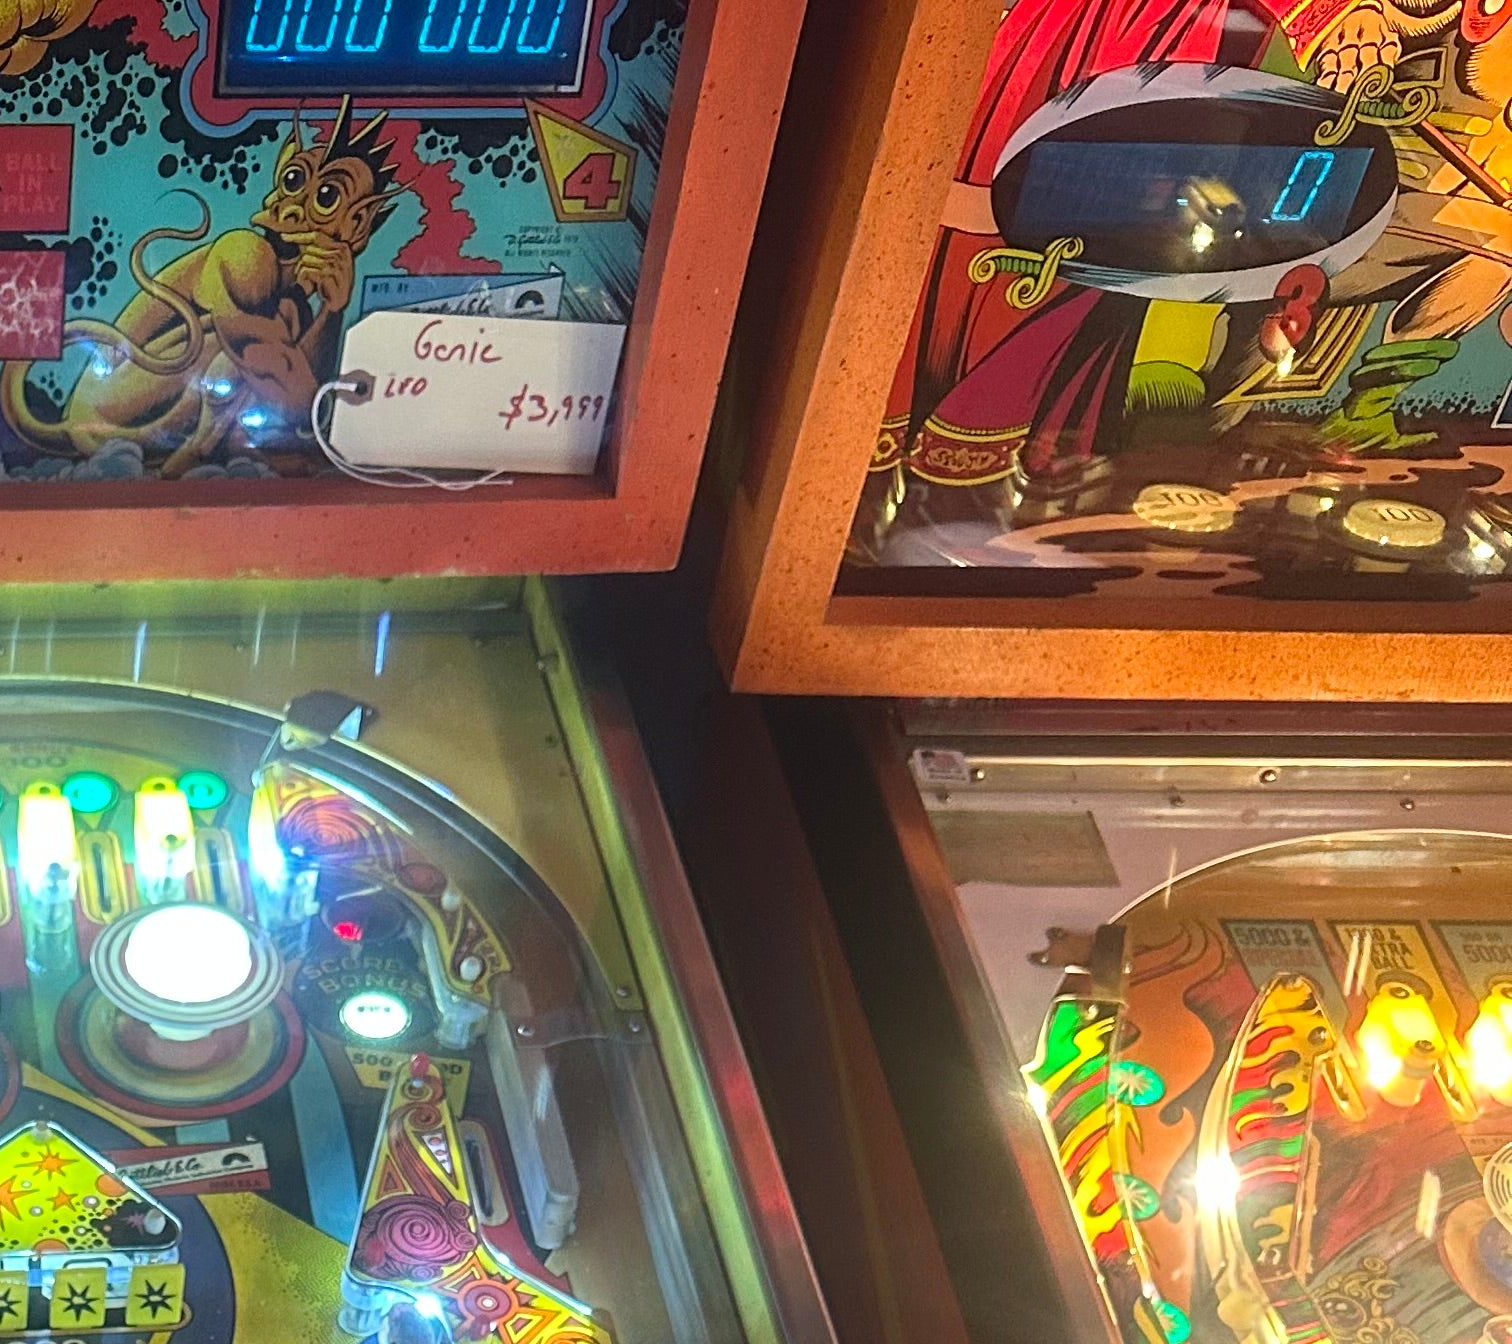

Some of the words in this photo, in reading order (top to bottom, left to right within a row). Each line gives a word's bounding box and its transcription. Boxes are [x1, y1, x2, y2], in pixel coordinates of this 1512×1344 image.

[563, 153, 623, 210] 4
[1270, 150, 1336, 222] 0
[498, 383, 606, 431] $3,999
